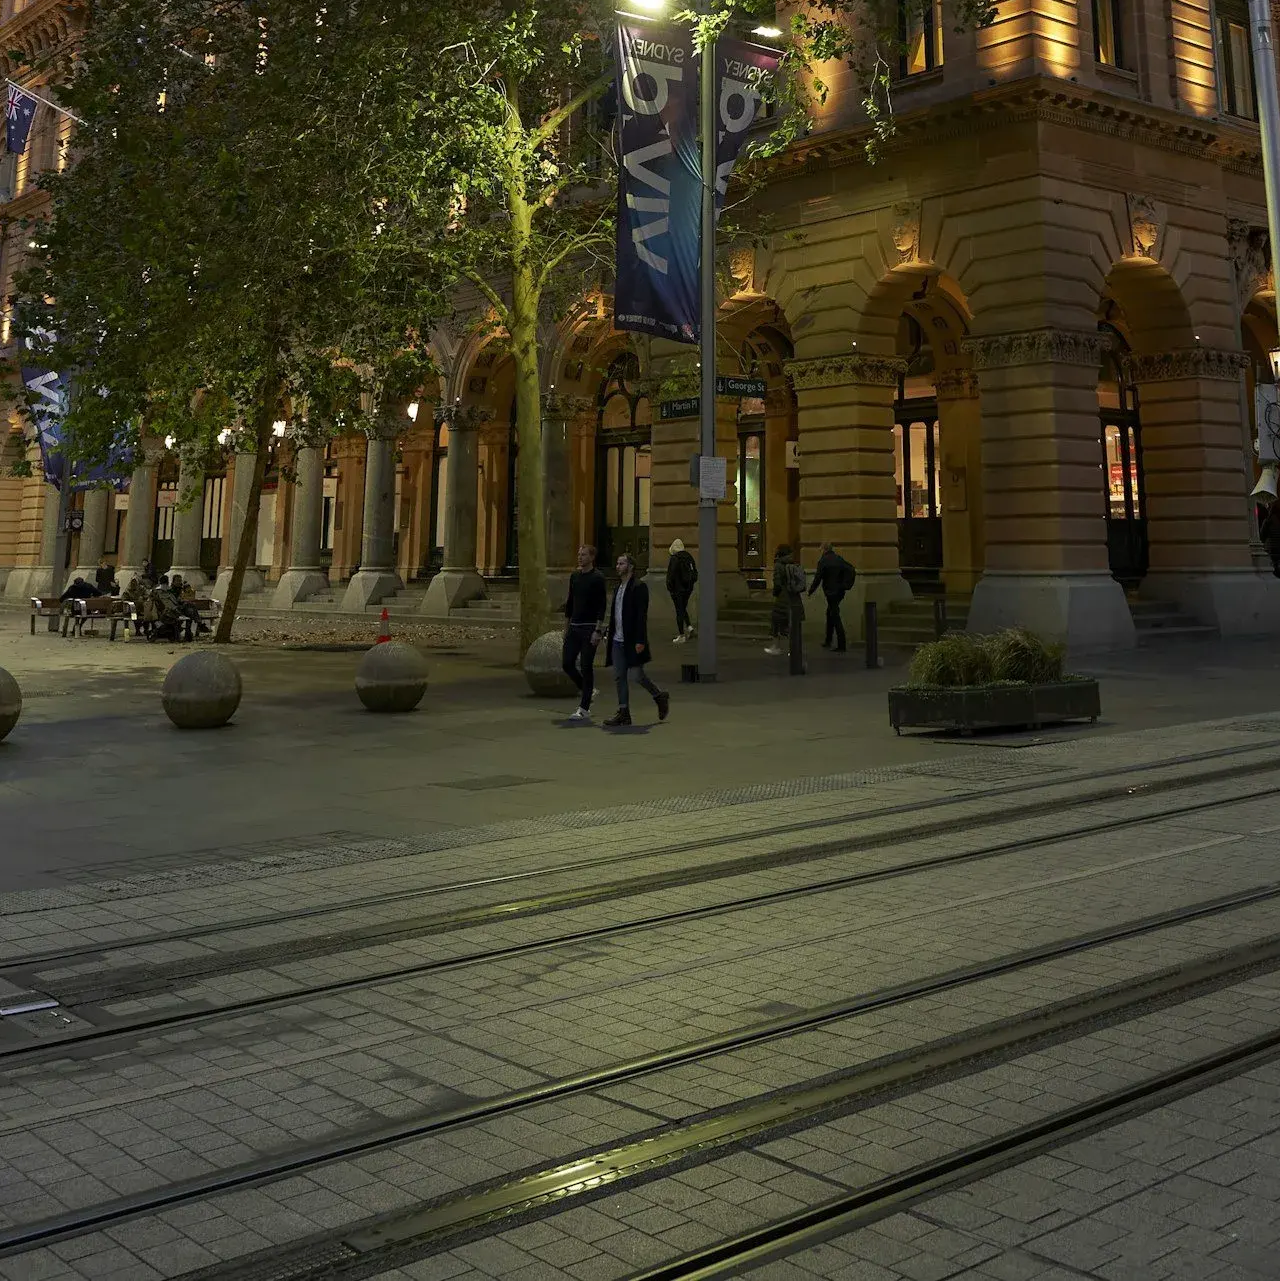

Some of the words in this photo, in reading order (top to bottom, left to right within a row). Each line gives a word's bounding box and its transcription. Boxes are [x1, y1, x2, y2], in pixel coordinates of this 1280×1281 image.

[728, 379, 756, 393] George
[757, 382, 765, 392] St
[671, 400, 691, 411] Martin
